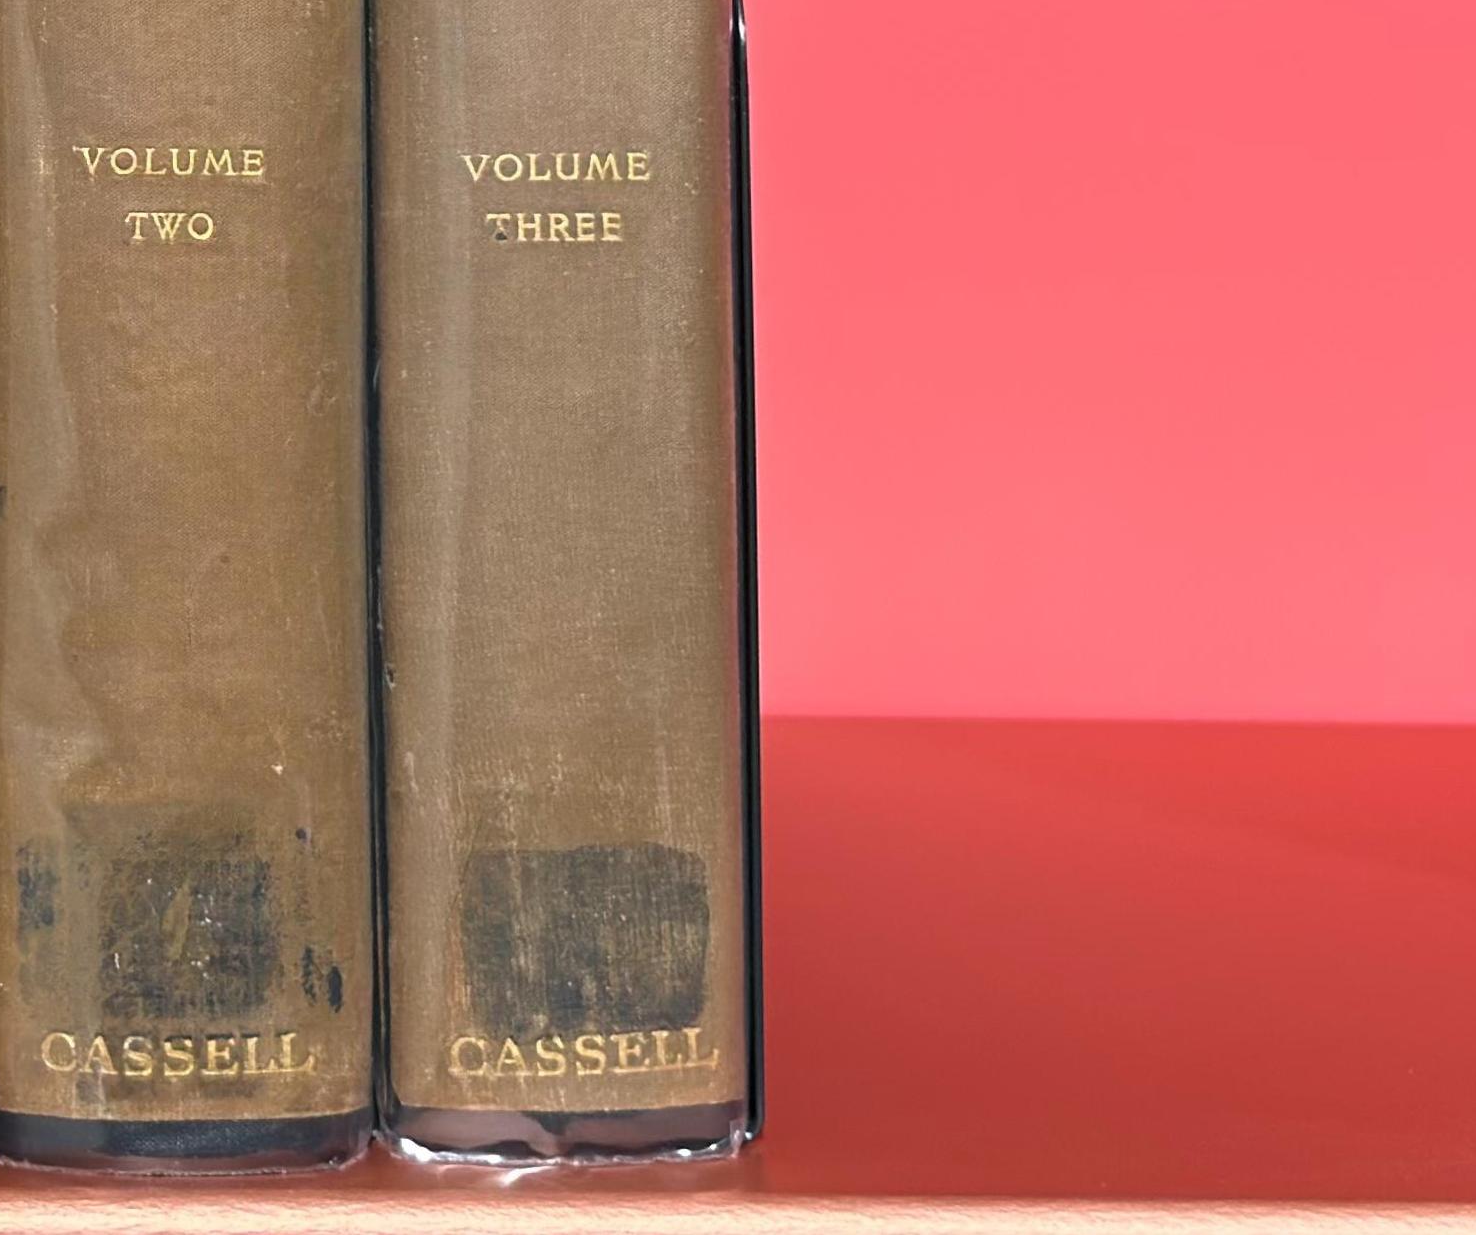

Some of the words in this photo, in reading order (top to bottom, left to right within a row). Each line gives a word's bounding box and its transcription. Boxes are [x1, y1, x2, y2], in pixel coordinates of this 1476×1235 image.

[75, 146, 265, 179] VOLUME
[462, 152, 651, 182] VOLUME
[124, 212, 213, 243] TWO
[485, 212, 623, 243] THREE
[41, 1032, 315, 1078] CASSELL
[449, 1027, 720, 1078] CASSELL
